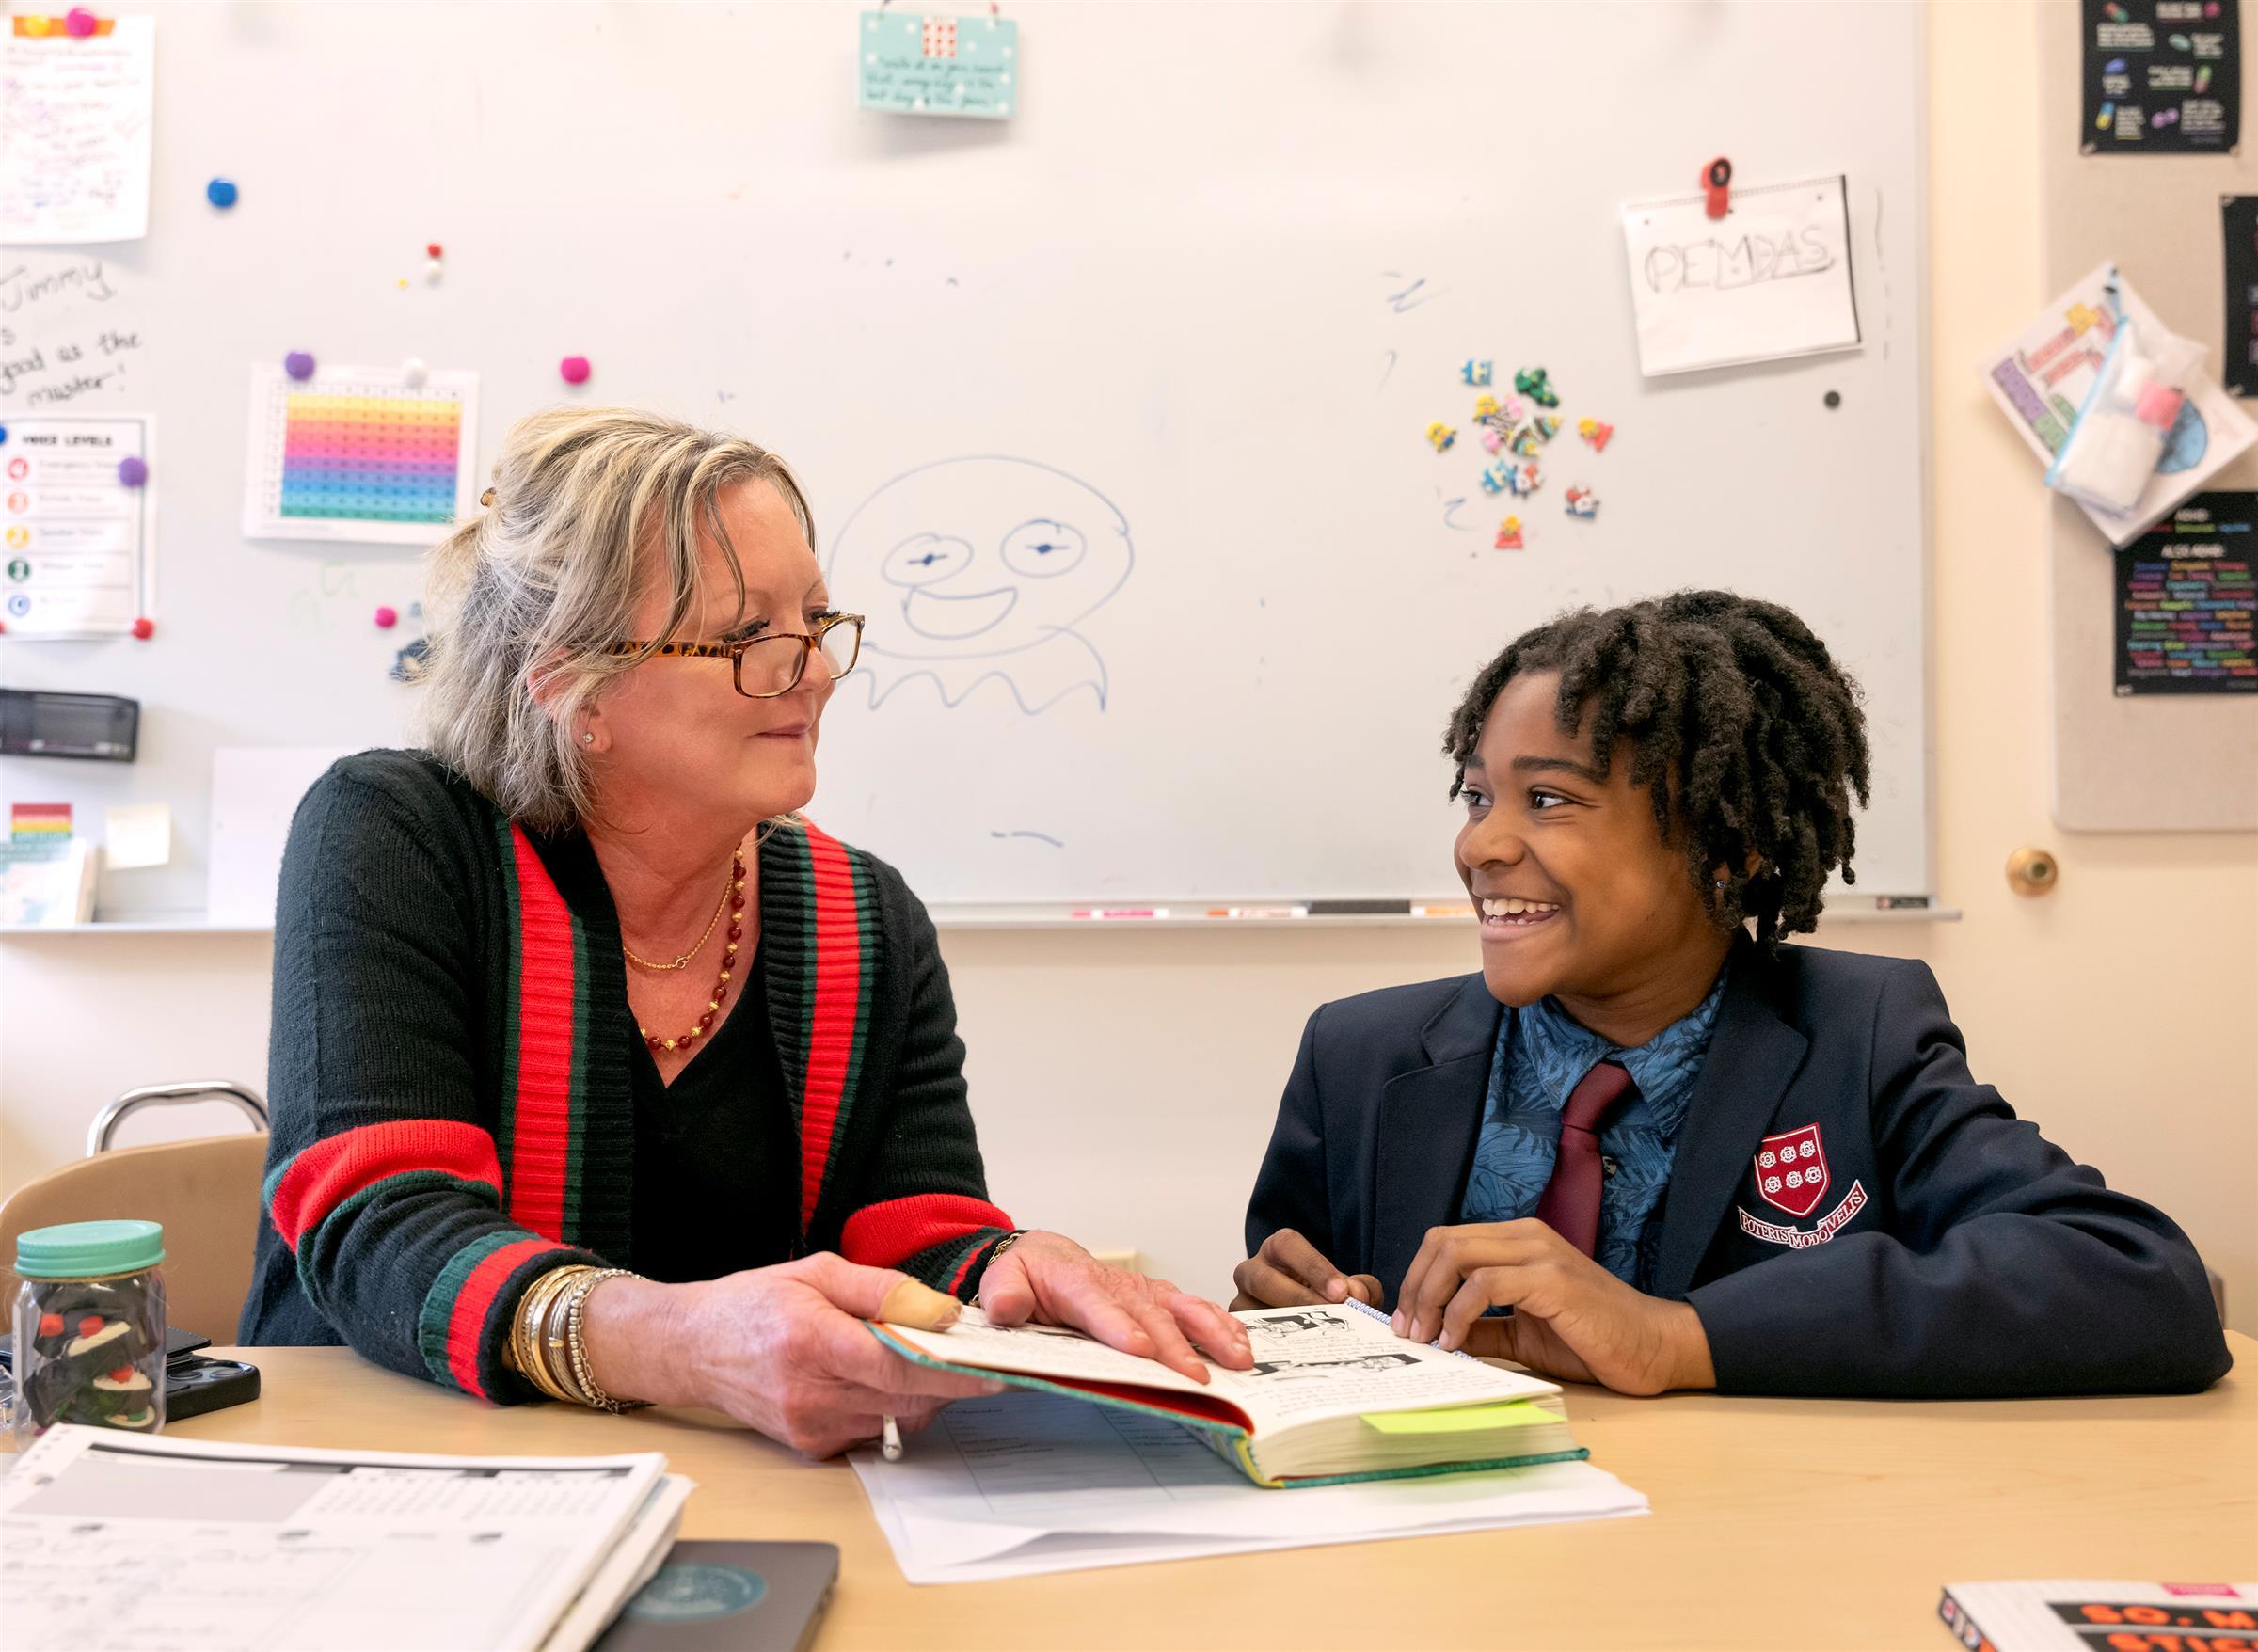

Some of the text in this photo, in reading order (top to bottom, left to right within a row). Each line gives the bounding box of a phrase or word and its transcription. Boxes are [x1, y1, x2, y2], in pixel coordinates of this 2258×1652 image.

[1645, 225, 1836, 294] PEMDAS
[1741, 1189, 1864, 1247] POTERIS MODO VELIS
